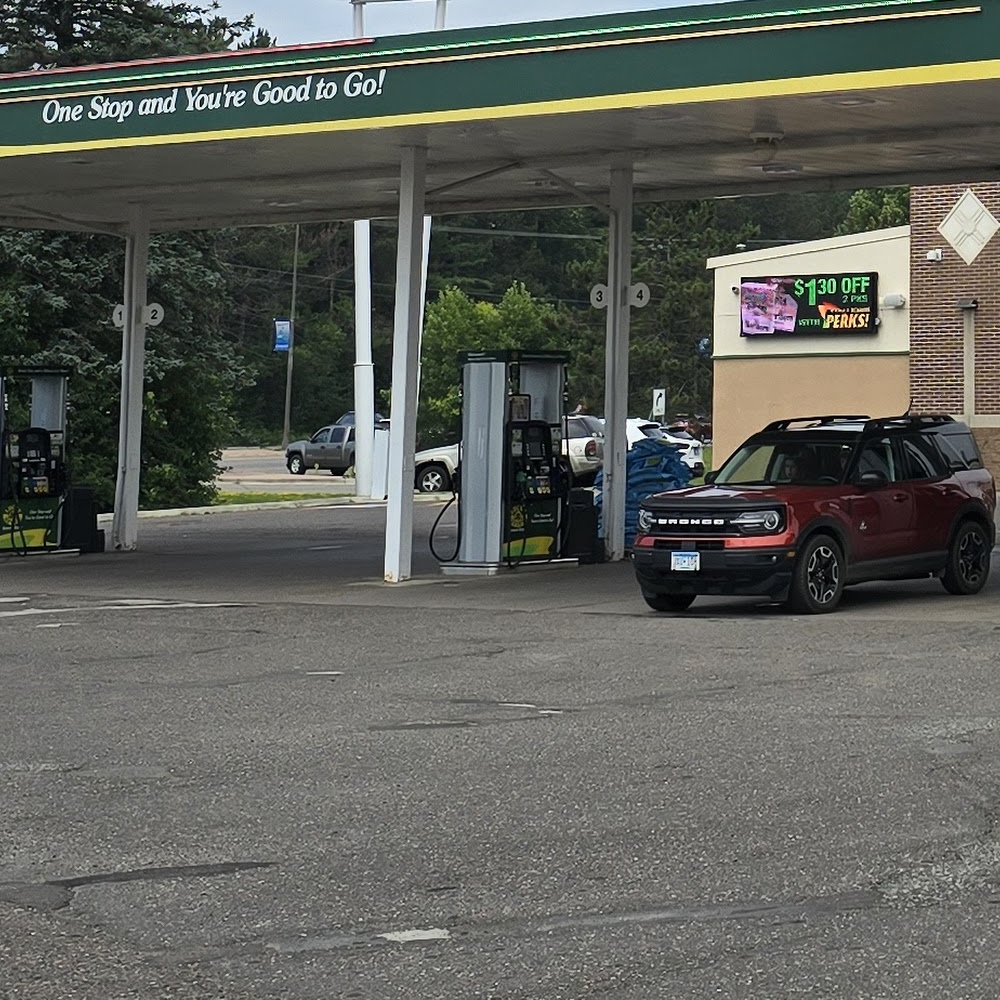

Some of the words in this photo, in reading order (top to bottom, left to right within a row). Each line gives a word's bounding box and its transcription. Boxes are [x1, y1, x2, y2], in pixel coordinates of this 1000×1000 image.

[42, 99, 82, 124] One
[88, 95, 133, 123] Stop
[138, 89, 178, 115] and
[184, 84, 246, 112] You're
[252, 75, 312, 105] Good
[315, 77, 338, 100] to
[343, 69, 387, 96] Go!
[841, 276, 870, 294] OFF
[595, 291, 603, 302] 3
[636, 289, 644, 300] 4
[117, 311, 122, 320] 1
[151, 309, 158, 319] 2
[825, 313, 870, 328] PERKS!
